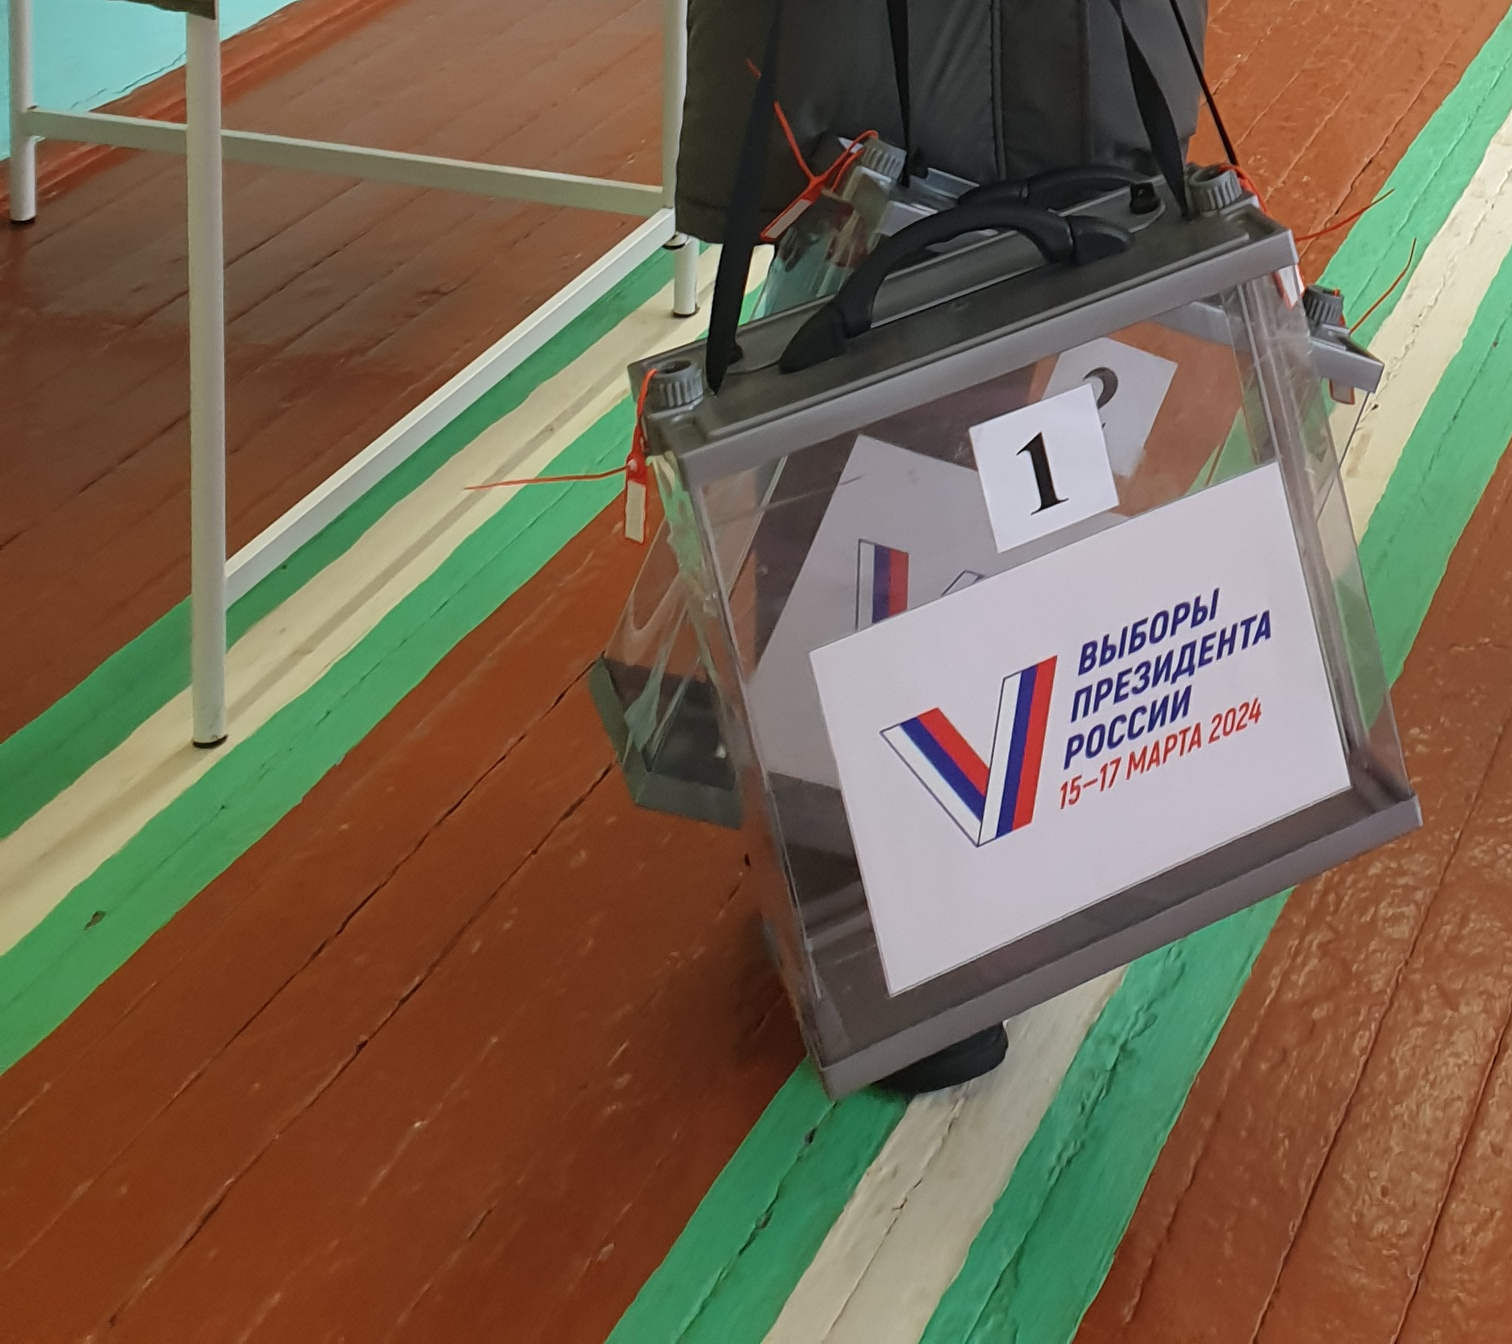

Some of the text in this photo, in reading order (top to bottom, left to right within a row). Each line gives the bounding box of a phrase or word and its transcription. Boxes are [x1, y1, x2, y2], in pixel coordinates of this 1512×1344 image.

[1016, 431, 1069, 516] 1
[1070, 610, 1272, 723] ПРЕЗИДЕНТА
[1077, 587, 1220, 676] ВЫБОРЫ
[1063, 684, 1193, 771] РОССИИ
[1126, 722, 1202, 780] МАРТА
[1208, 697, 1262, 744] 2024
